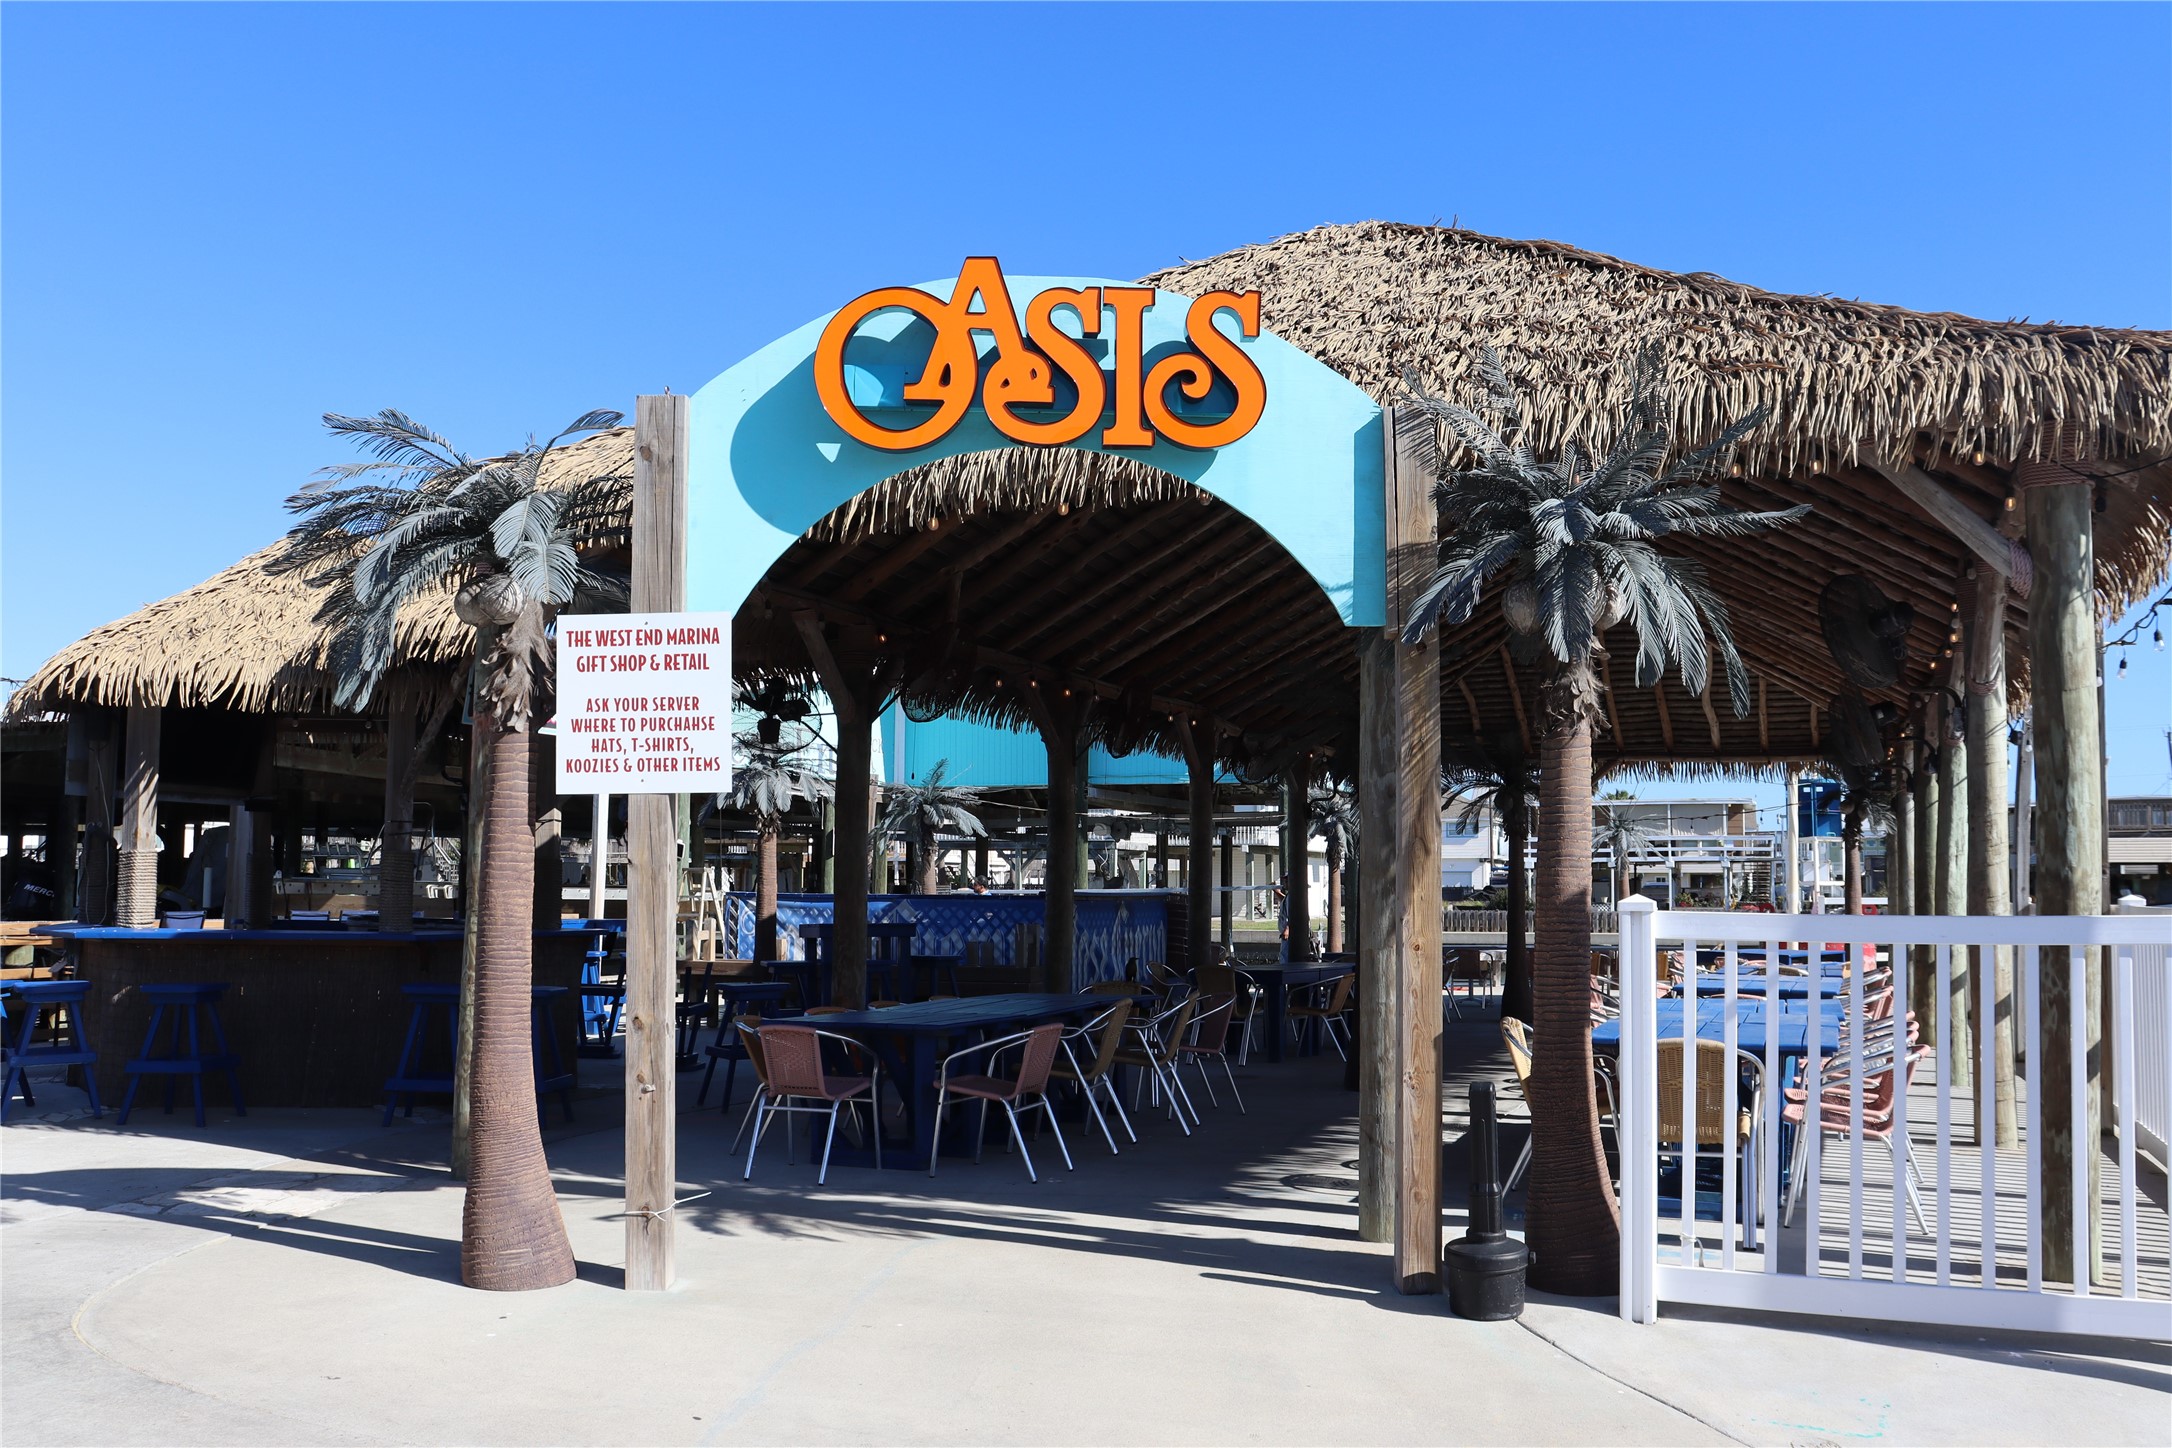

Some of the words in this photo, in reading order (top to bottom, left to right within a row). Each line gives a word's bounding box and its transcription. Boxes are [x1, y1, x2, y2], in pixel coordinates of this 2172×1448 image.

[813, 256, 1267, 450] OASIS
[567, 630, 591, 647] THE
[596, 629, 632, 647] WEST
[636, 629, 663, 646] END
[667, 628, 719, 645] MARINA
[577, 655, 607, 672] GIFT
[610, 654, 646, 672] SHOP
[650, 654, 660, 671] &
[664, 653, 709, 670] RETAIL
[587, 699, 608, 712] ASK
[615, 698, 648, 711] YOUR
[653, 697, 699, 711] SERVER
[572, 718, 615, 732] WHERE
[622, 718, 635, 732] TO
[641, 716, 714, 731] PURCHAHSE
[591, 738, 627, 755] HATS,
[632, 737, 694, 754] T-SHIRTS,
[566, 758, 618, 773] KOOZIES
[623, 758, 632, 772] &
[638, 757, 678, 772] OTHER
[683, 757, 720, 771] ITEMS
